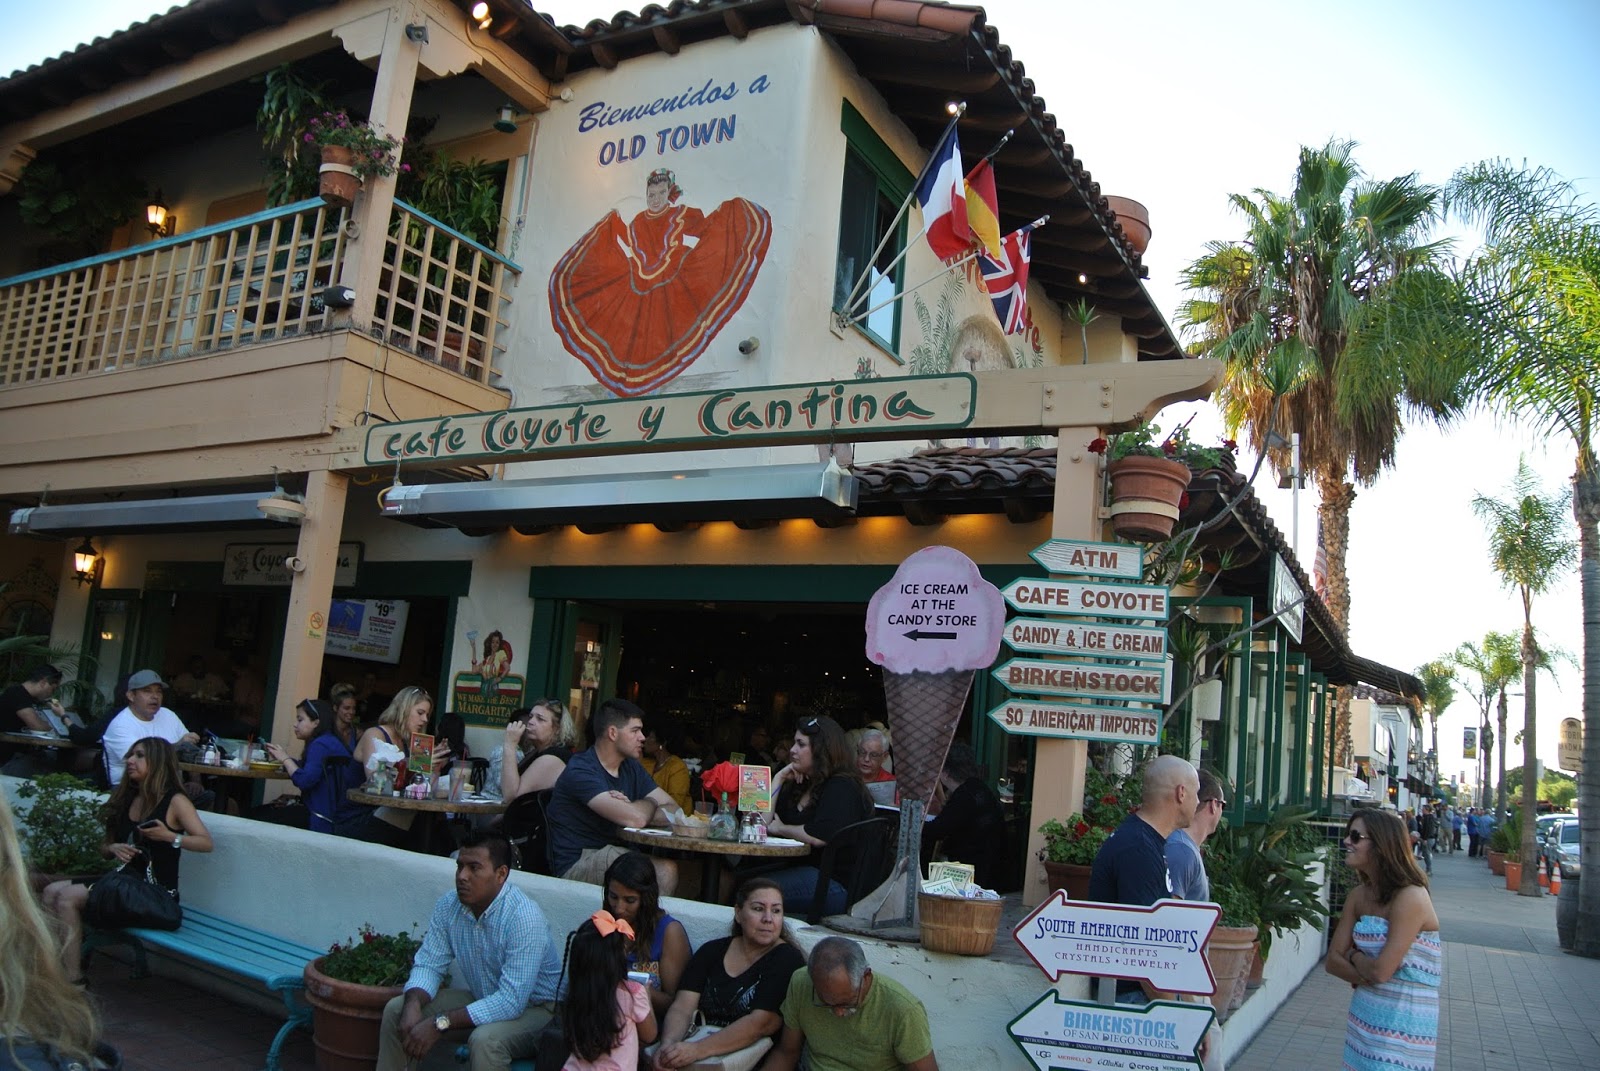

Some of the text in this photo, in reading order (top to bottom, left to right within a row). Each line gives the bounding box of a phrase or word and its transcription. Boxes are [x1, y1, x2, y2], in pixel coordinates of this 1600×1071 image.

[578, 74, 770, 133] Bienvenidos a
[598, 114, 737, 167] OLD TOWN
[481, 405, 611, 452] Coyote
[638, 405, 665, 441] y
[698, 383, 935, 437] Cantina
[253, 547, 295, 572] Coyo
[1070, 549, 1118, 569] ATM
[900, 584, 968, 595] ICE CREAM
[1015, 586, 1164, 612] CAFE COYOTE
[911, 599, 955, 610] AT THE
[888, 614, 977, 626] CANDY STORE
[1012, 625, 1163, 653] CANDY & ICE CREAM
[1008, 666, 1160, 694] BIRKENSTOCK
[499, 694, 519, 705] BEST
[1005, 707, 1157, 736] SO AMERICAN IMPORTS
[1035, 917, 1198, 953] SOUTH AMERICAN IMPORTS
[1054, 952, 1178, 970] CRYSTALS JEWELRY
[1076, 943, 1158, 957] HANDICRAFTS
[1063, 1029, 1078, 1038] OF
[1079, 1030, 1099, 1040] SAN
[1102, 1033, 1135, 1044] DIEGO
[1064, 1011, 1176, 1039] BIRKENSTOCK
[1035, 1050, 1051, 1058] UGG
[1137, 1063, 1159, 1071] crocs
